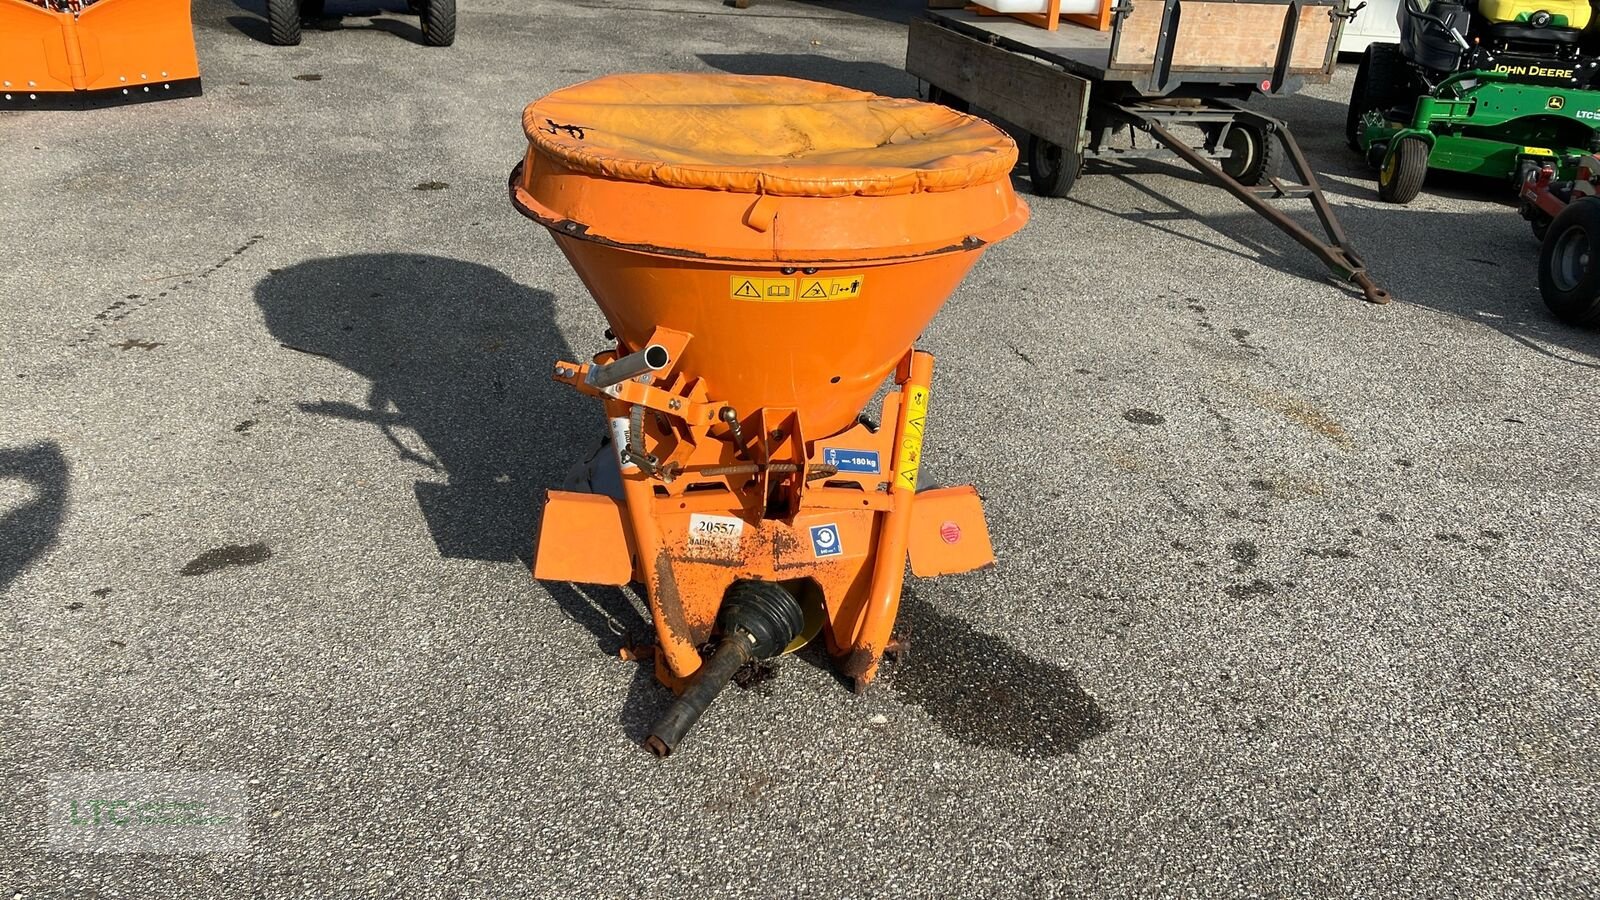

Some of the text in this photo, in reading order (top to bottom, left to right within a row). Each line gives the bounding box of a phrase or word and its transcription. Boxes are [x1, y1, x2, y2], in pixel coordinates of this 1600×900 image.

[1490, 63, 1574, 78] JOHN DEERE
[851, 457, 866, 466] 180
[867, 459, 876, 468] kg
[699, 520, 736, 536] 20557
